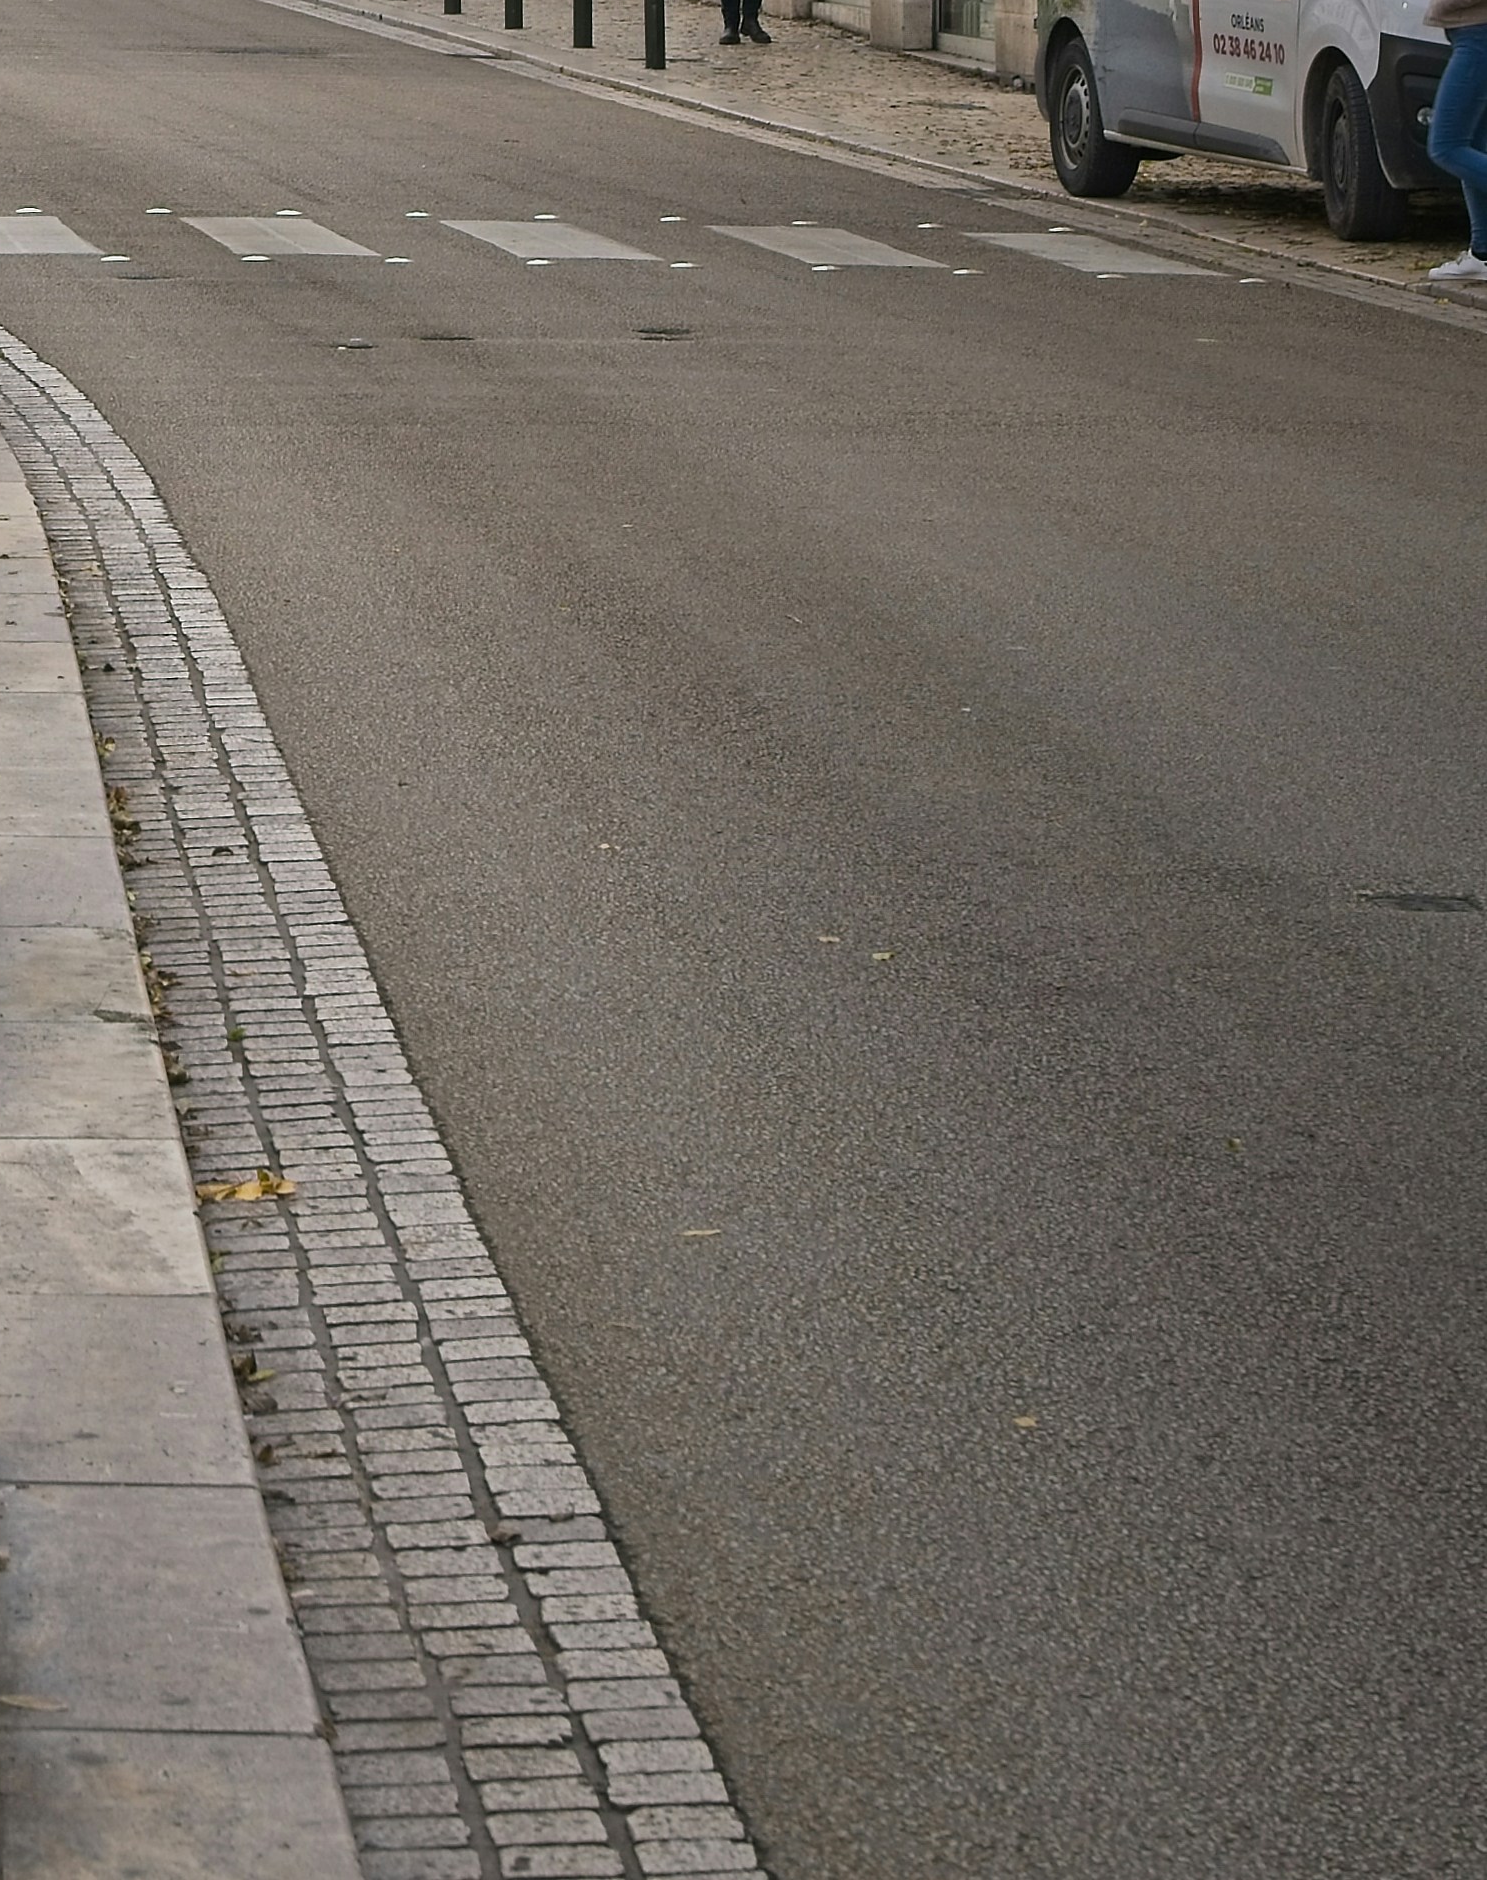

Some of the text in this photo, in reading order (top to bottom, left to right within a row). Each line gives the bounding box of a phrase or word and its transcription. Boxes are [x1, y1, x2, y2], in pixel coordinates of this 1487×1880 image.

[1231, 12, 1265, 32] ORLÉANS
[1213, 33, 1285, 65] 02 38 46 24 10
